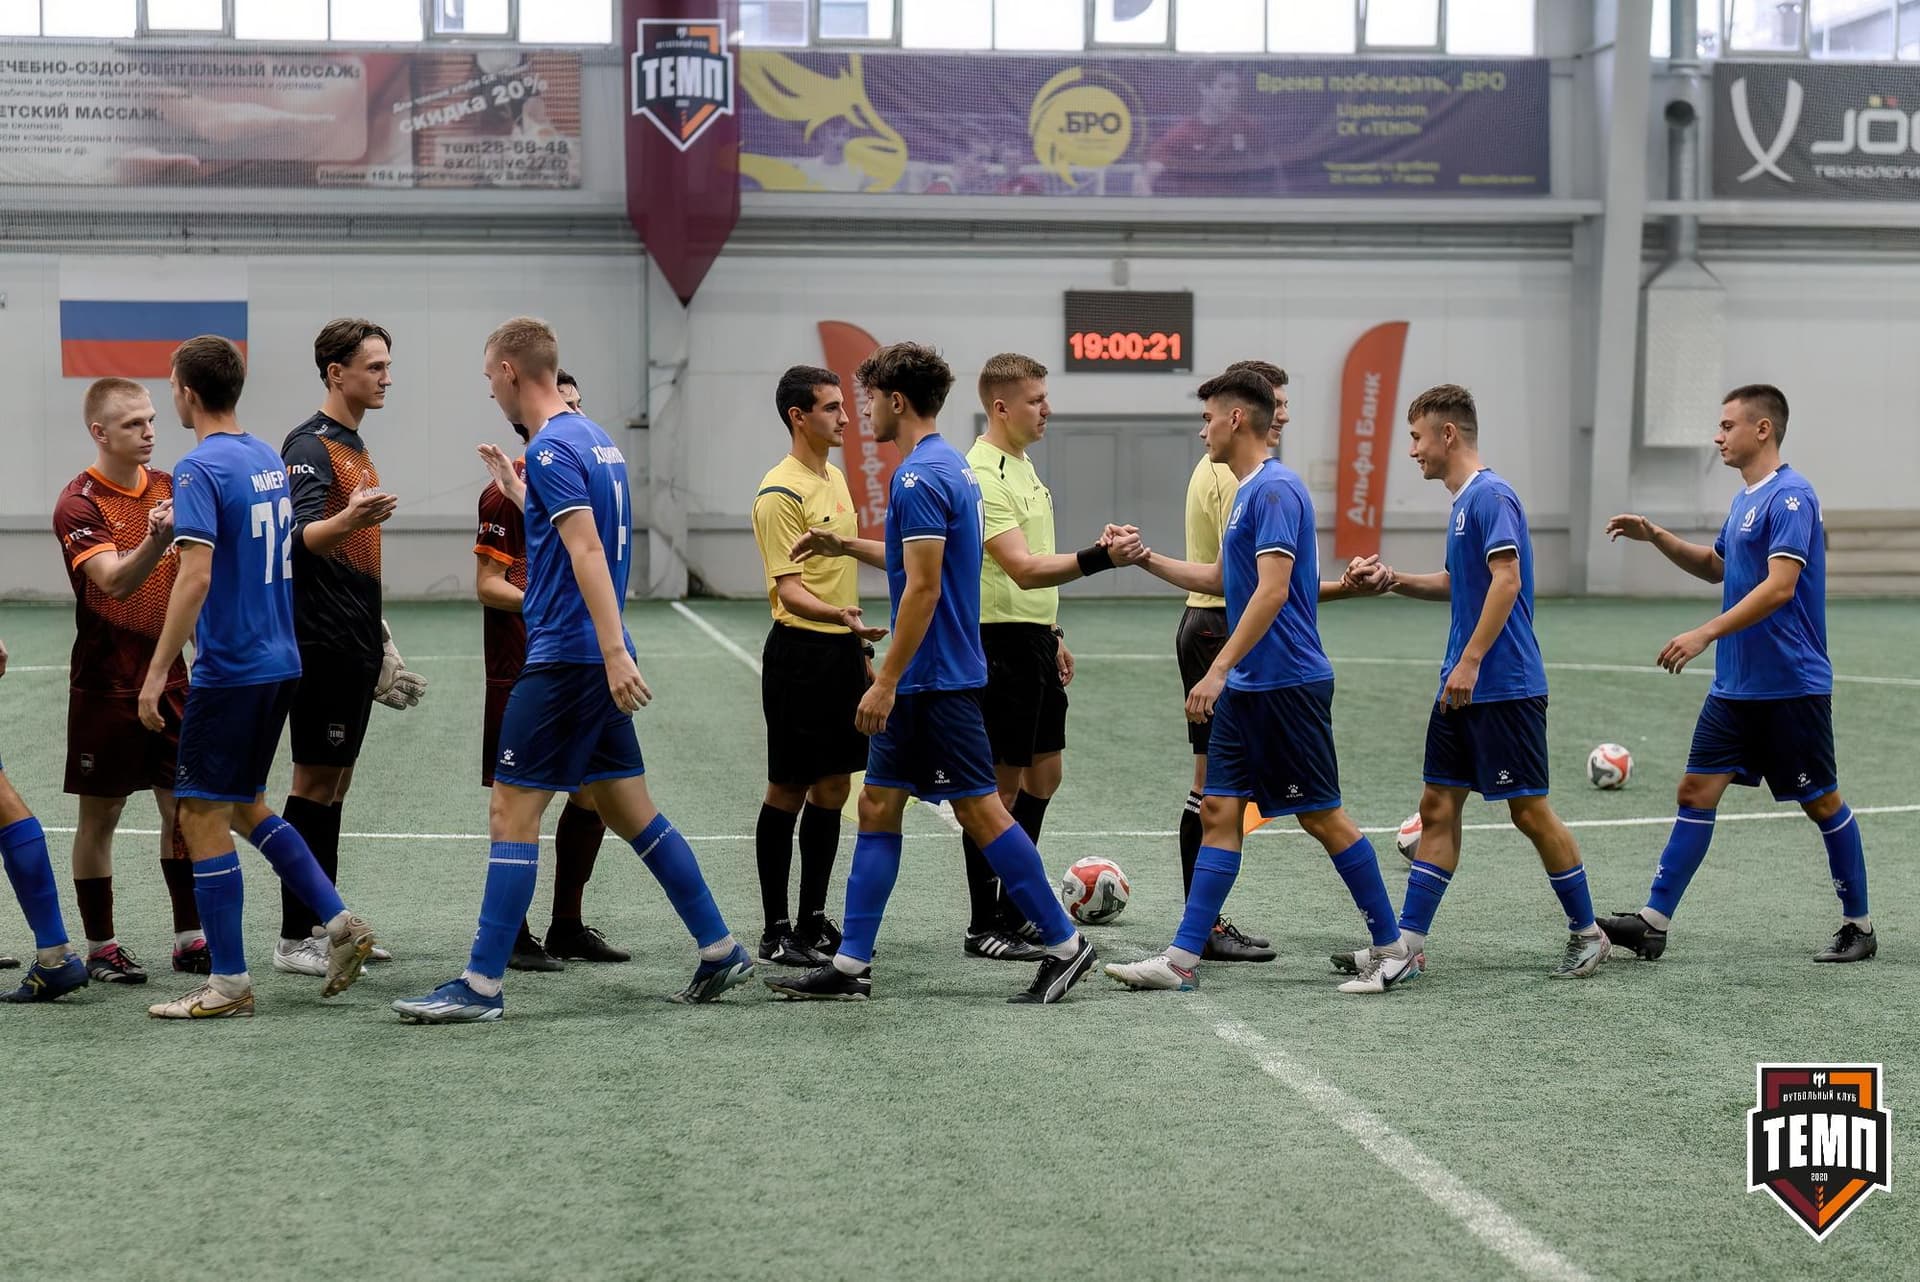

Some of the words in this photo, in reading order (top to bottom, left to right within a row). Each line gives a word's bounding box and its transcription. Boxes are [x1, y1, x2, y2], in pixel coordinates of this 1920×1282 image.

[272, 63, 360, 79] МАССАЖ:
[641, 55, 724, 101] ТЕМП
[1255, 73, 1324, 93] Время
[75, 105, 165, 122] МАССАЖ:
[399, 95, 487, 133] скидка
[492, 73, 548, 105] 20%
[1069, 332, 1181, 361] 19:00:21
[1355, 371, 1382, 437] Банк
[250, 470, 286, 494] МАЙЕР
[1347, 440, 1375, 527] Альфа
[250, 496, 294, 585] 72
